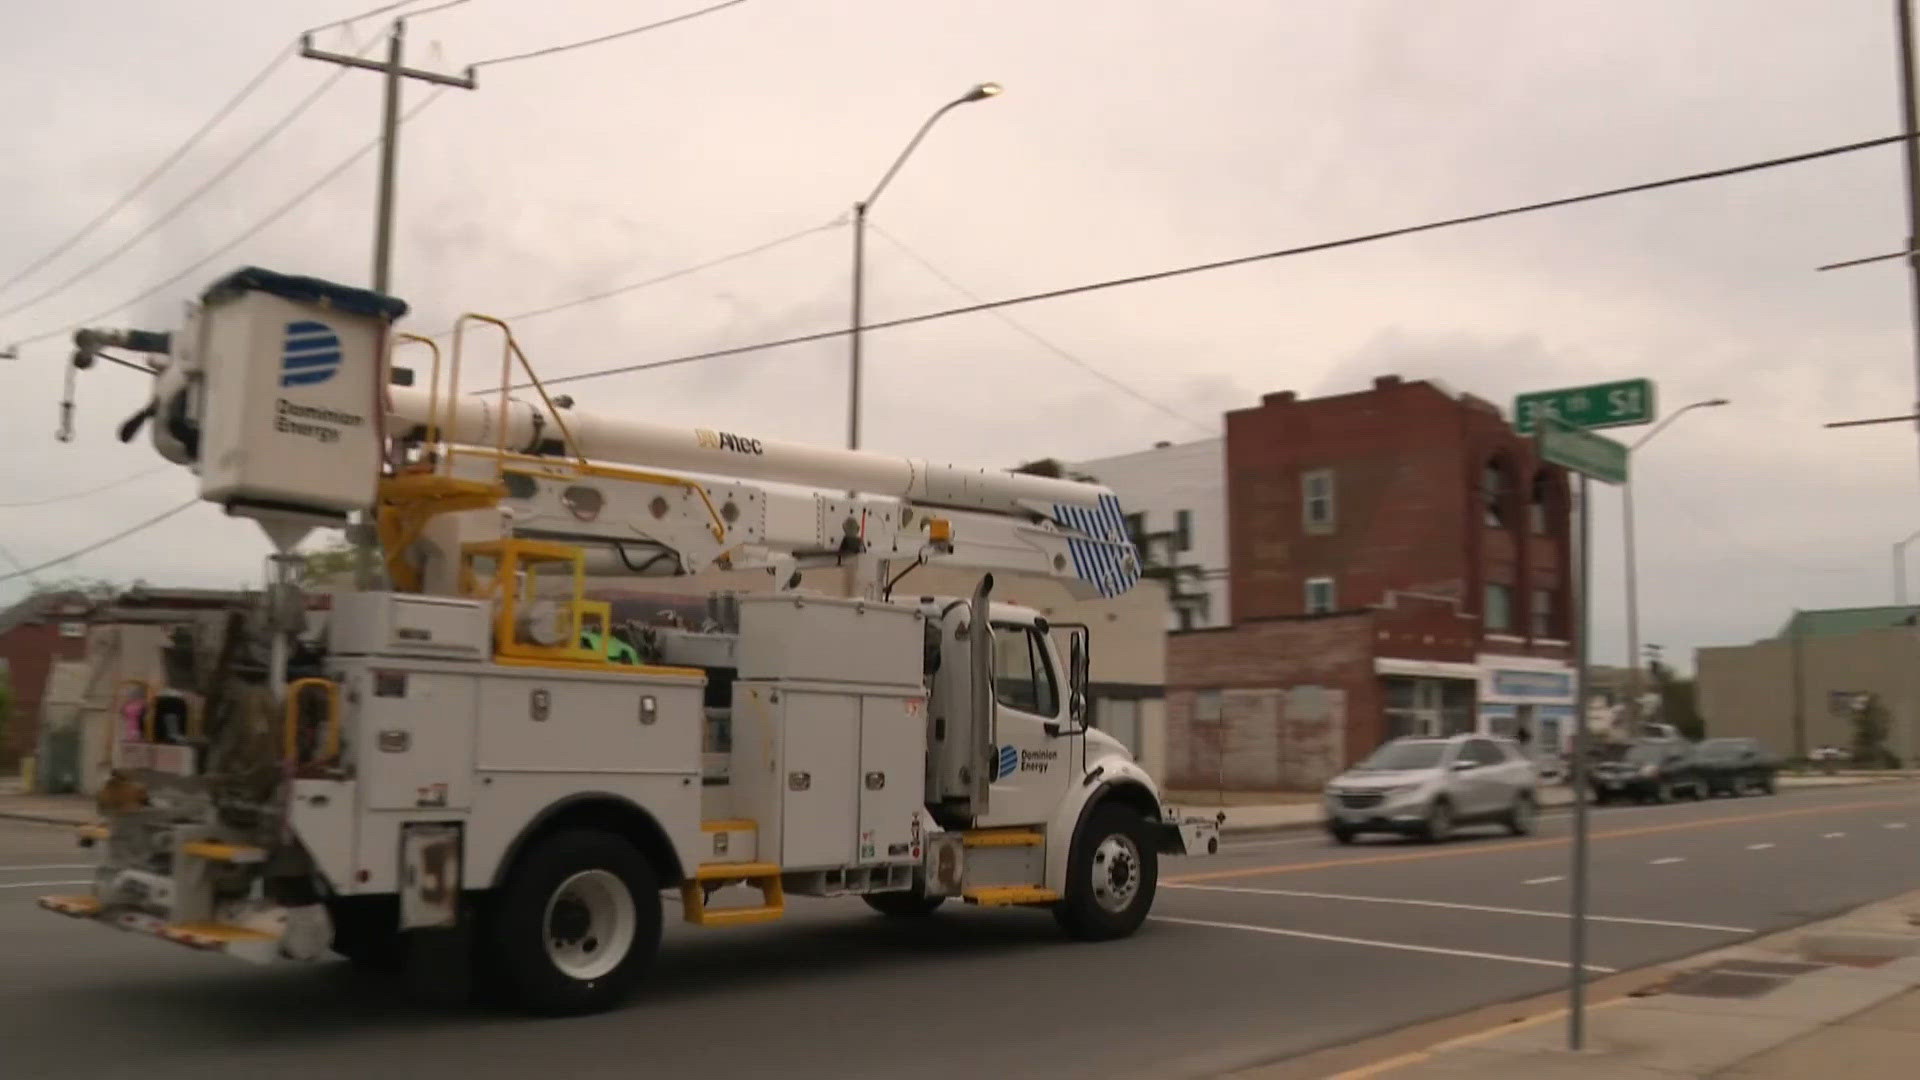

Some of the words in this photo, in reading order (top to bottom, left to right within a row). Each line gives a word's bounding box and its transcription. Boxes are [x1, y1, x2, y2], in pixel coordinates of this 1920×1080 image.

[277, 399, 364, 424] Dominion
[1607, 388, 1640, 416] St
[276, 417, 341, 442] Energy
[719, 432, 763, 456] Altec
[1021, 750, 1057, 761] Dominion
[1021, 762, 1048, 774] Energy
